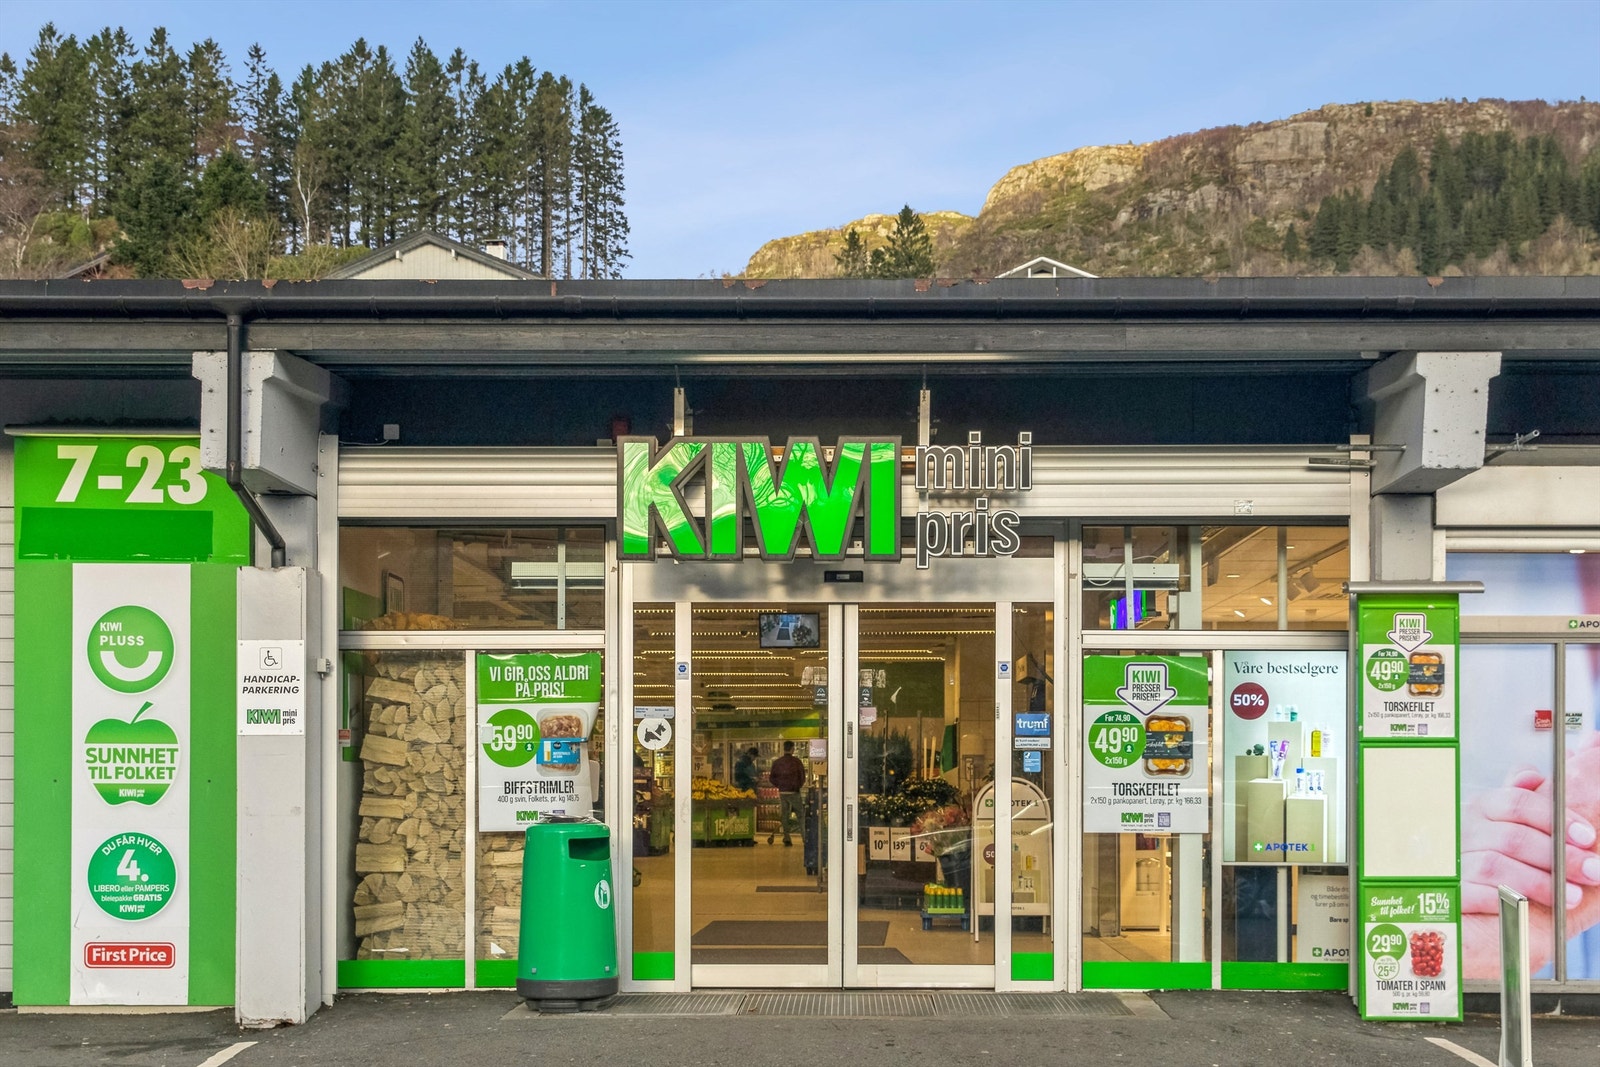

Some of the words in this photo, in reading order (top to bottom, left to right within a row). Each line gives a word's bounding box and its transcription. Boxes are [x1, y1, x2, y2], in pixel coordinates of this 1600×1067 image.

[914, 430, 1033, 490] mini
[55, 445, 208, 504] 7-23
[617, 435, 901, 562] KIWI
[915, 497, 1021, 569] pris
[99, 622, 122, 632] KIWI
[1399, 619, 1421, 628] KIWI
[99, 635, 145, 646] PLUSS
[490, 666, 501, 682] VI
[504, 666, 523, 682] GIR
[528, 666, 551, 682] OSS
[554, 664, 589, 681] ALDRI
[1233, 660, 1263, 675] Våre
[1266, 662, 1339, 677] bestselgere
[243, 675, 300, 684] HANDICAP-
[1132, 671, 1161, 683] KIWI
[242, 686, 300, 695] PARKERING
[515, 678, 531, 697] PÅ
[534, 682, 565, 697] PRIS!
[1132, 683, 1161, 692] PRESSER
[1132, 692, 1161, 701] PRISENE!
[1233, 694, 1265, 706] 50%
[1384, 701, 1435, 712] TORSKEFILET
[246, 709, 281, 725] KIWI
[282, 709, 298, 718] mini
[282, 717, 296, 725] pris
[1017, 718, 1048, 729] trumf
[85, 747, 178, 764] SUNNHET
[1105, 756, 1122, 765] 2x150
[1123, 757, 1128, 766] g
[88, 766, 112, 780] TIL
[114, 766, 176, 780] FOLKET
[504, 780, 575, 795] BIFFSTRIMLER
[1112, 783, 1181, 796] TORSKEFILET
[119, 789, 137, 798] KIWI
[509, 796, 514, 804] g
[558, 794, 566, 803] kg
[1107, 797, 1112, 805] g
[1175, 797, 1182, 805] kg
[516, 811, 538, 821] KIWI
[1121, 812, 1144, 823] KIWI
[101, 841, 117, 856] DU
[115, 835, 136, 847] FÅR
[136, 836, 163, 856] HVER
[1265, 843, 1309, 852] APOTEK
[116, 849, 149, 882] 4.
[133, 894, 163, 902] GRATIS
[1371, 895, 1404, 906] Sunnhet
[1417, 893, 1450, 914] 15%
[119, 904, 137, 913] KIWI
[1380, 906, 1389, 915] til
[92, 948, 127, 962] First
[129, 948, 167, 962] Price
[1376, 980, 1413, 991] TOMATER
[1420, 980, 1446, 991] SPANN
